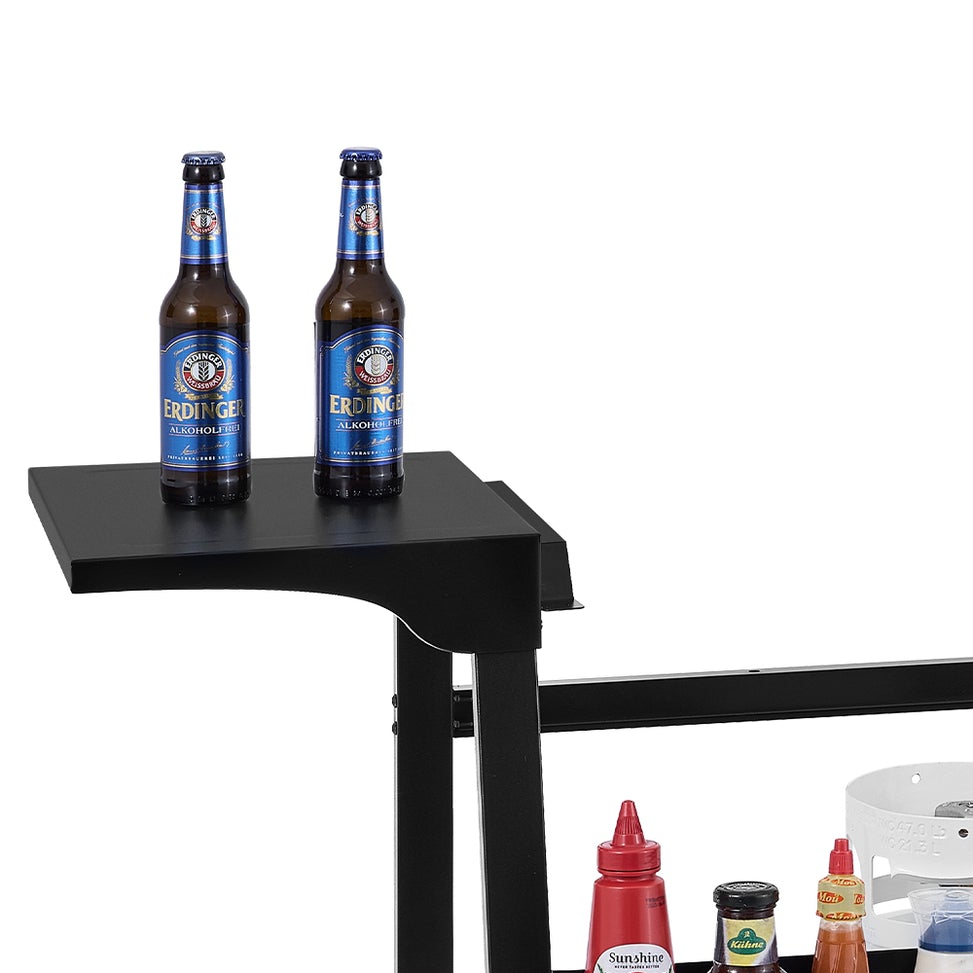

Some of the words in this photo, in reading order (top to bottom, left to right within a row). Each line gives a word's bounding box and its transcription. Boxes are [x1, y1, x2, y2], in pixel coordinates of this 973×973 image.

[184, 352, 223, 369] ERDINGER
[357, 348, 392, 365] ERDINGER
[164, 399, 246, 422] ERDINGER
[170, 424, 240, 435] ALKOHOLFREI
[337, 418, 403, 430] ALKOHOLFRE
[609, 951, 664, 964] Sunshine
